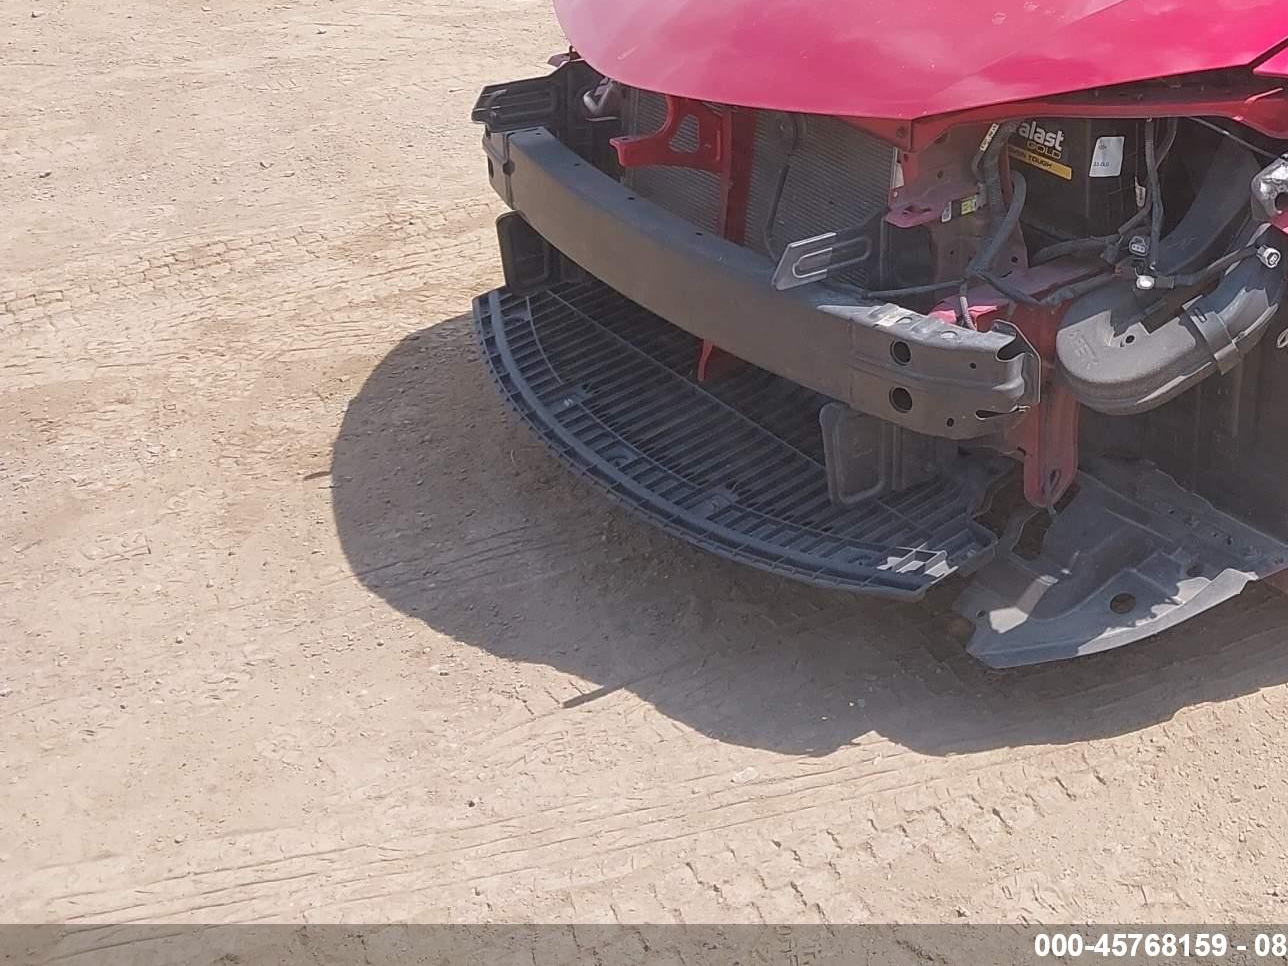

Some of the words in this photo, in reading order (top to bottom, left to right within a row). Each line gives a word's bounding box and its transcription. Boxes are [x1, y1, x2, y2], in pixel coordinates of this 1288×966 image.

[1018, 120, 1065, 152] alast
[1026, 140, 1062, 160] GOLD
[1028, 154, 1053, 169] TOUGH
